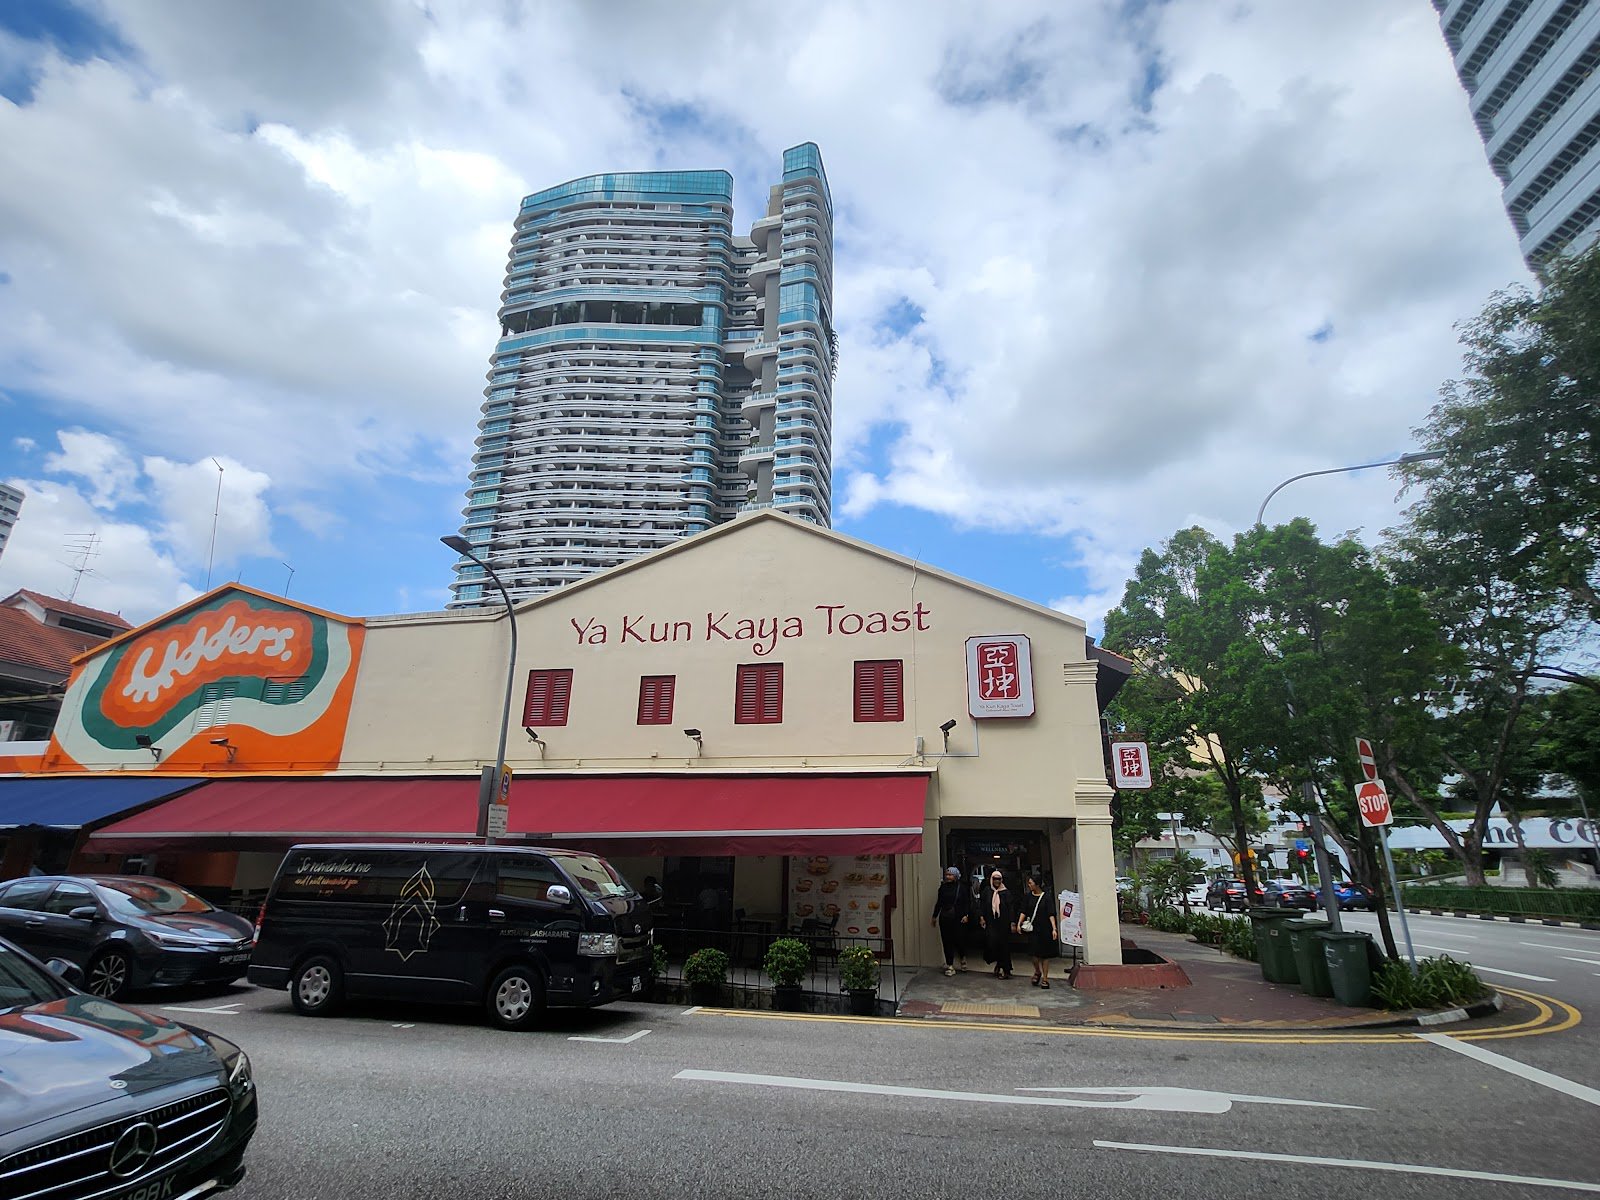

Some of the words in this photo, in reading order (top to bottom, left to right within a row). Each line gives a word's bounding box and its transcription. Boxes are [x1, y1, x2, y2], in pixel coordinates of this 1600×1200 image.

[570, 617, 607, 645] Ya
[620, 615, 693, 643] Kun
[706, 612, 803, 656] Kaya
[815, 602, 931, 635] Toast
[1359, 793, 1388, 814] STOP
